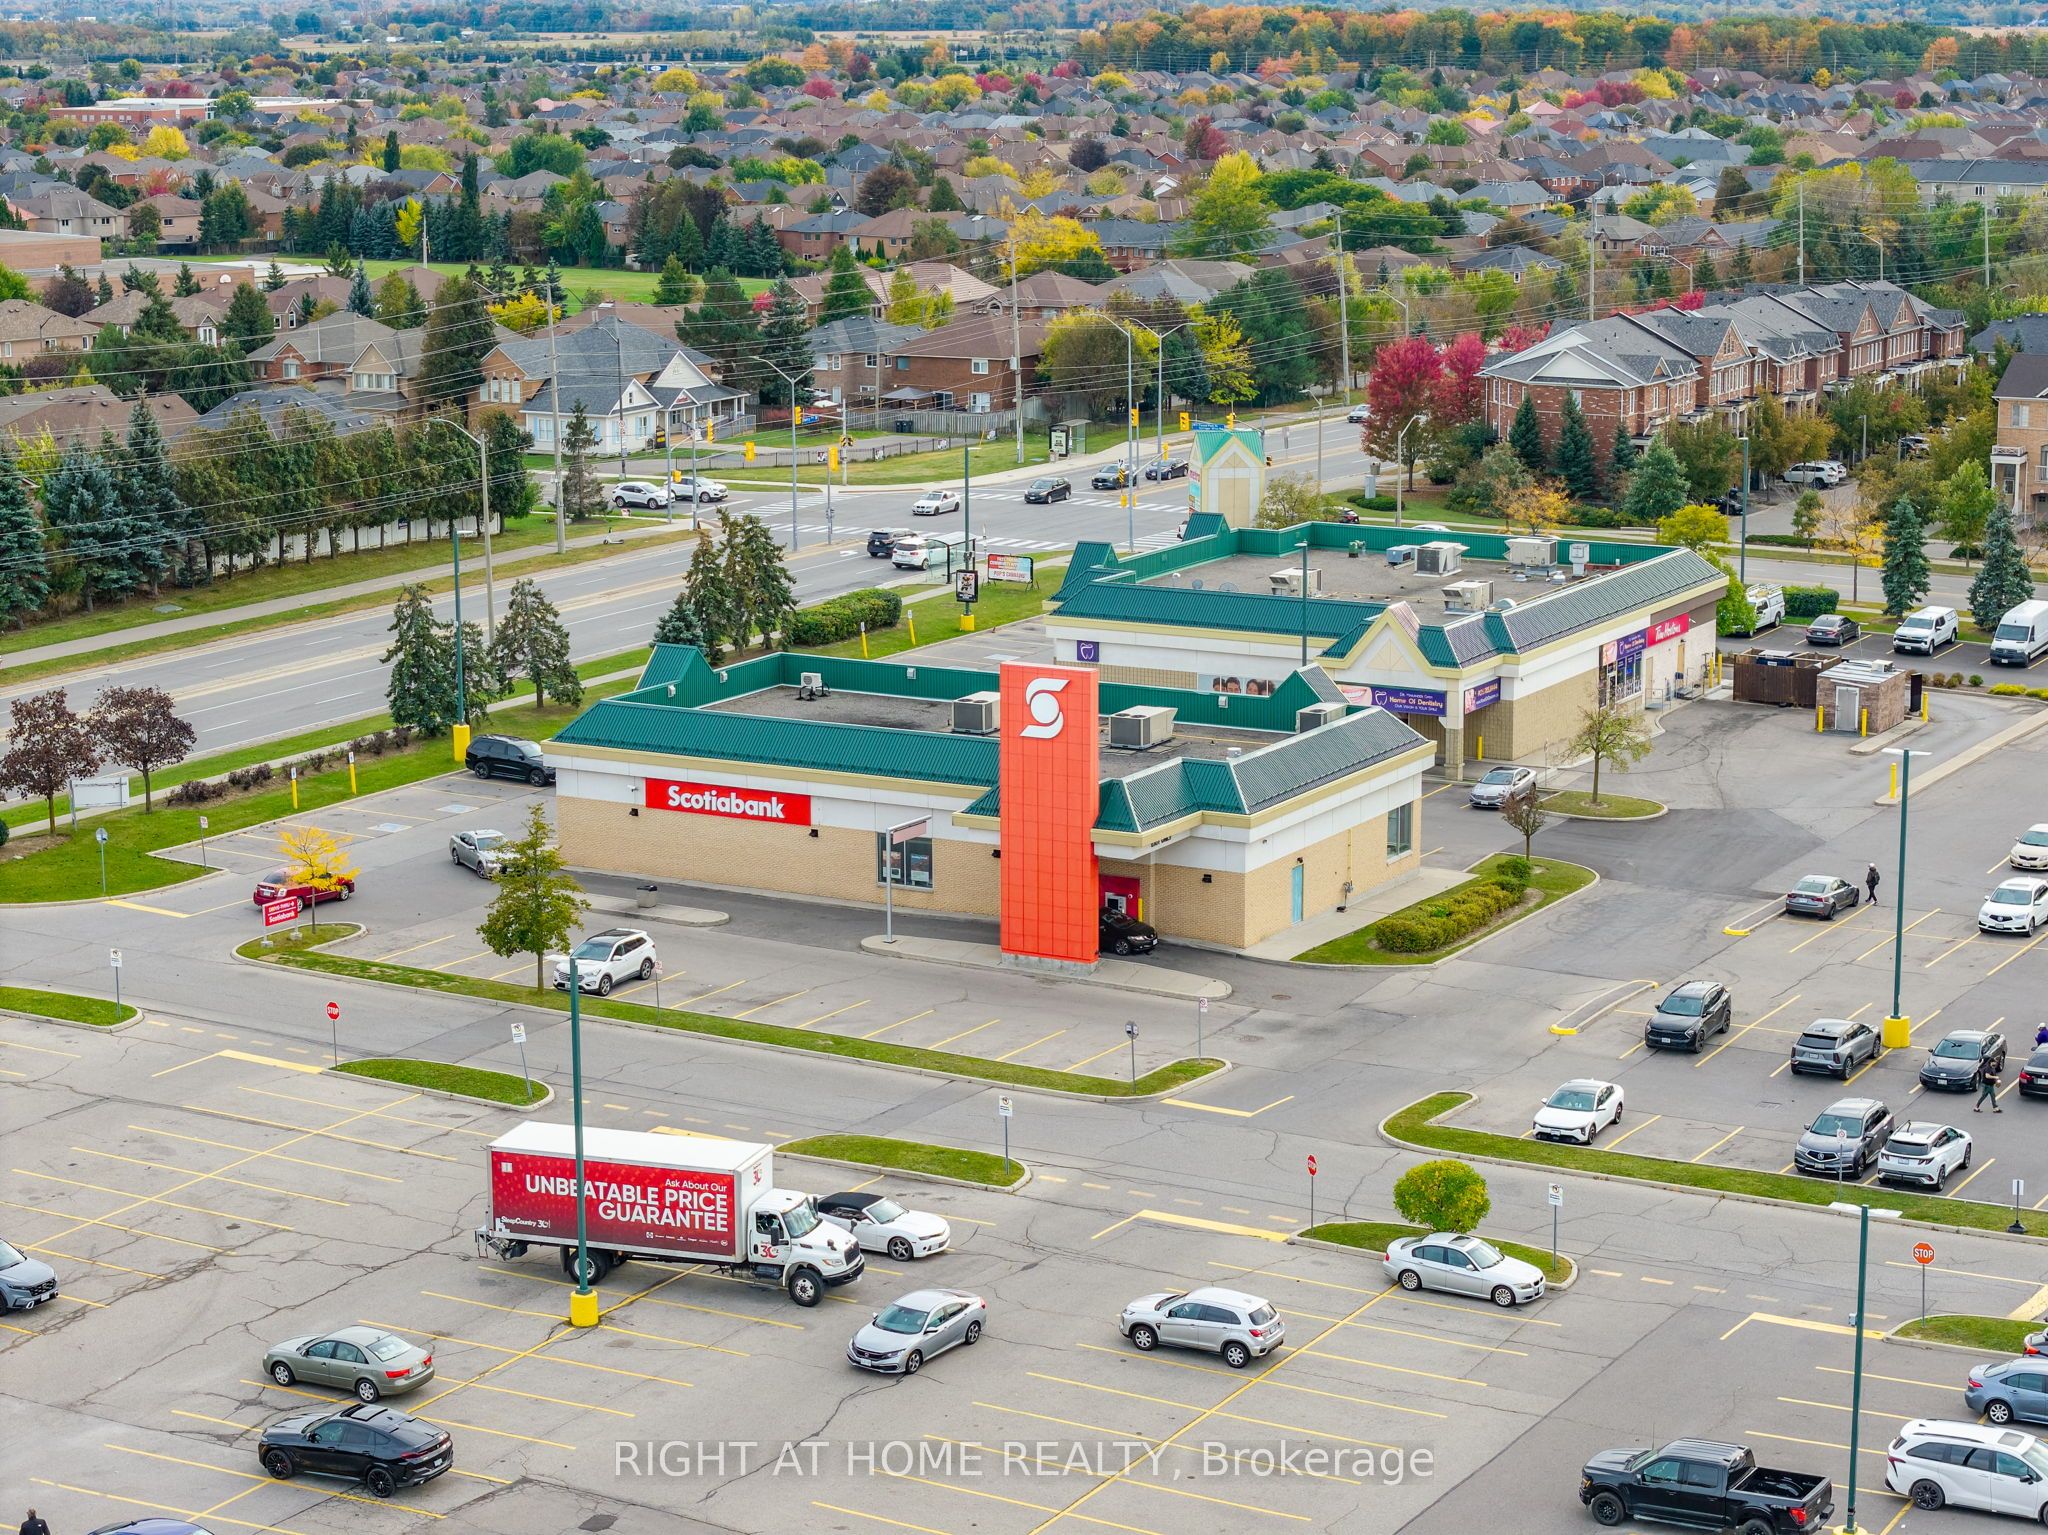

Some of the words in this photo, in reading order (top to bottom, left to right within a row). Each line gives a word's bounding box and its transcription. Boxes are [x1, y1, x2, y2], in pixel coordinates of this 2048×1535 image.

[1417, 700, 1443, 709] Dentistry
[667, 785, 785, 819] Scotiabank
[269, 910, 295, 923] Scotiabank
[328, 1006, 339, 1014] STOP
[665, 1179, 680, 1188] Ask
[682, 1180, 709, 1191] About
[710, 1183, 727, 1192] Our
[525, 1174, 659, 1206] UNBEATABLE
[665, 1188, 728, 1213] PRICE
[598, 1201, 729, 1232] GUARANTEE
[1914, 1248, 1934, 1259] STOP
